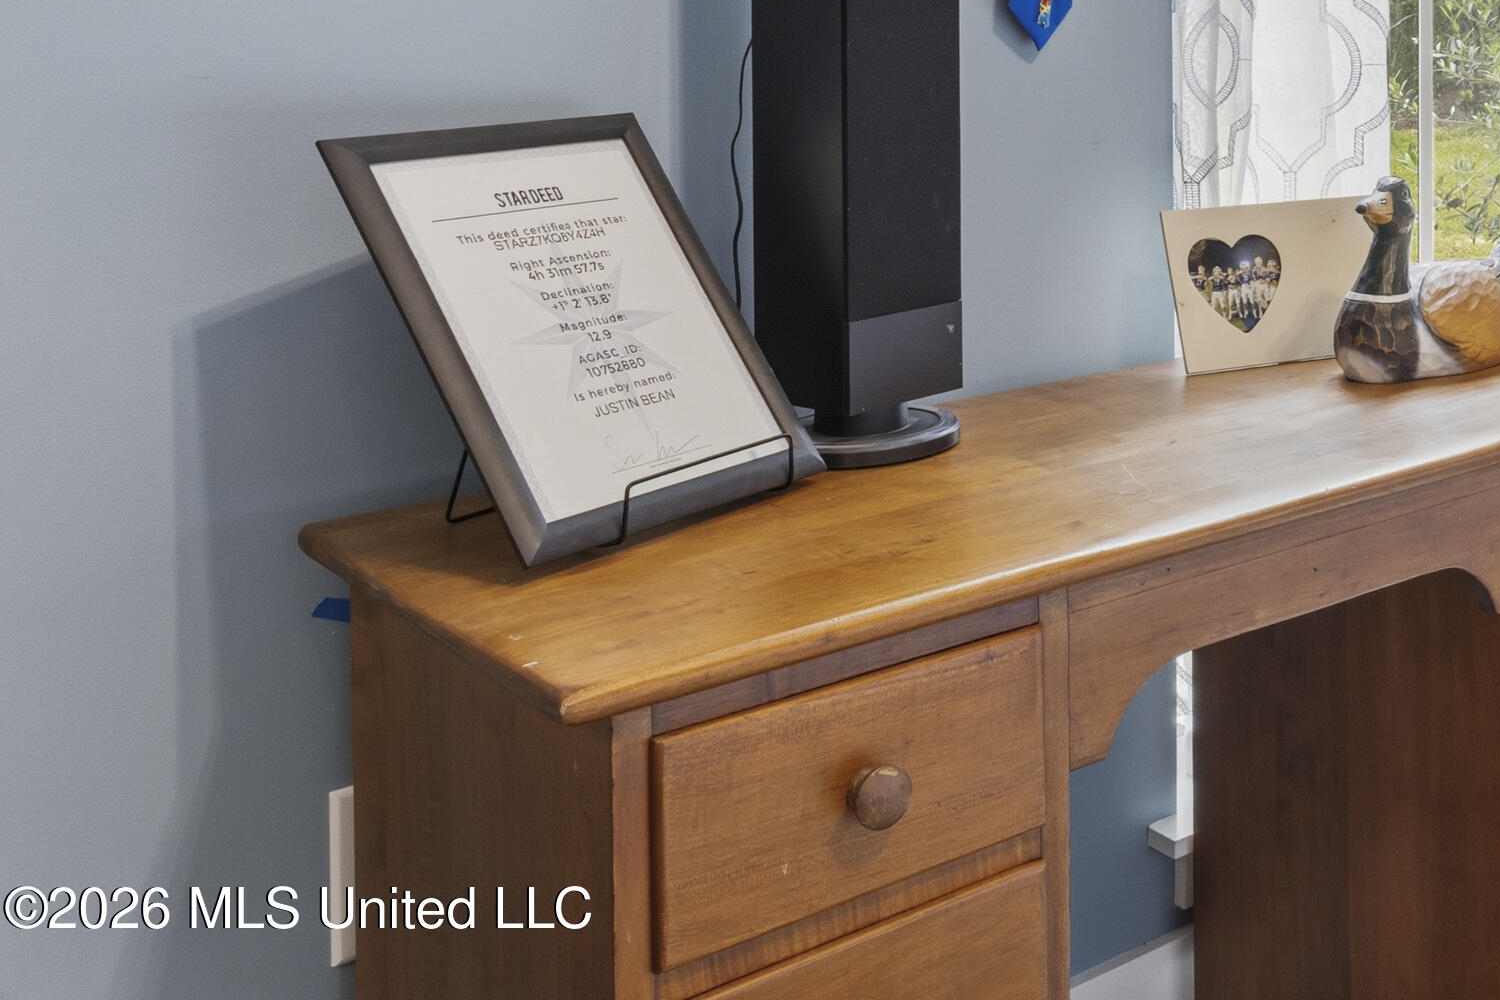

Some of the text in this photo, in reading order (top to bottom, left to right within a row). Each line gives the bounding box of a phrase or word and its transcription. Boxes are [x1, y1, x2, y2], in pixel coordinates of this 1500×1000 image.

[456, 214, 628, 245] This deed certifies that star:
[510, 249, 612, 272] Right Ascension:
[528, 270, 545, 281] 4h
[546, 266, 573, 279] 31m
[540, 281, 614, 301] Declination:
[560, 312, 628, 333] Magnitude:
[588, 329, 612, 342] 12.9
[588, 382, 630, 399] hereby
[633, 371, 677, 388] named:
[594, 388, 676, 418] JUSTIN BEAN
